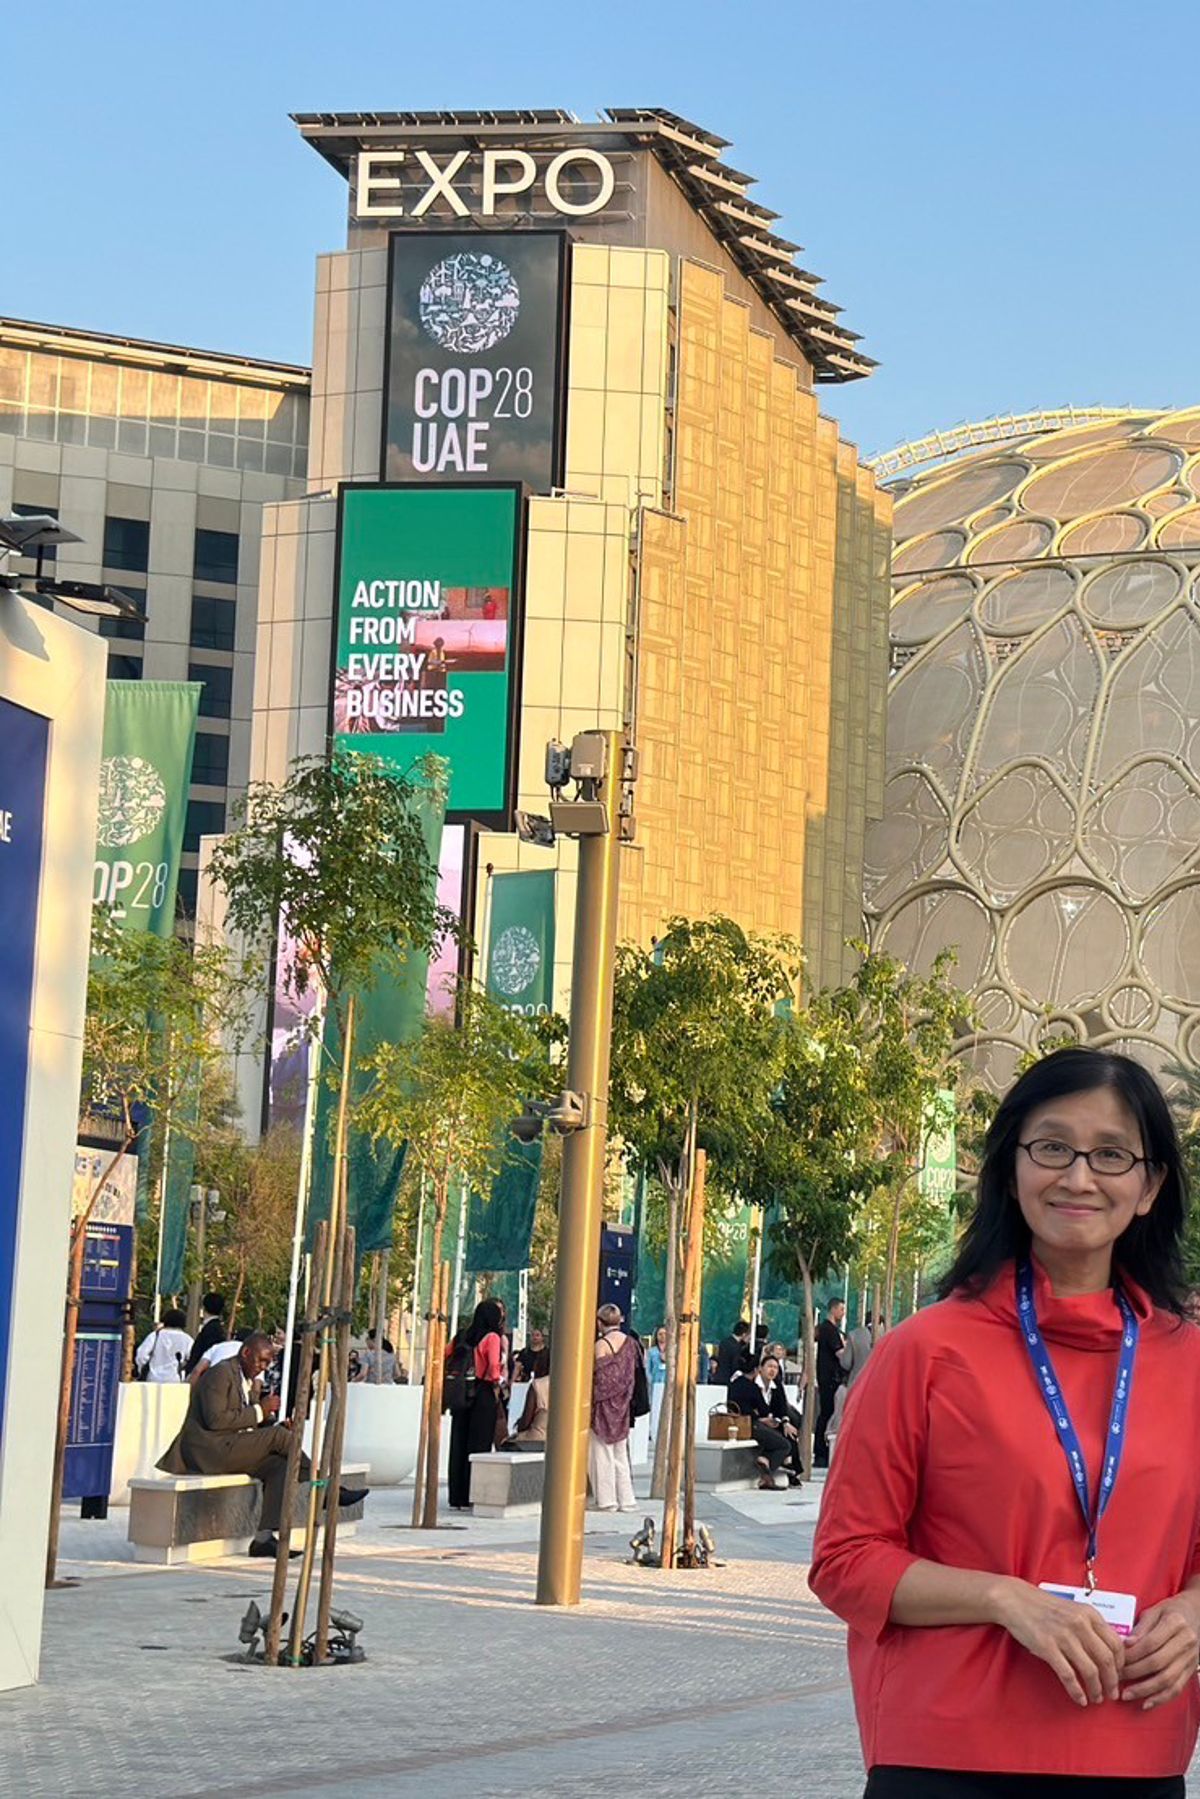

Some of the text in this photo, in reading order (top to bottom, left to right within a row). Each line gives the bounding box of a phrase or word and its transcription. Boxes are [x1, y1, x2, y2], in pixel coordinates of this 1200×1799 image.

[356, 149, 615, 217] EXPO
[414, 367, 533, 418] COP28
[412, 422, 489, 472] UAE
[352, 581, 440, 608] ACTION
[350, 617, 417, 644] FROM
[348, 653, 425, 681] EVERY
[346, 689, 464, 718] BUSINESS
